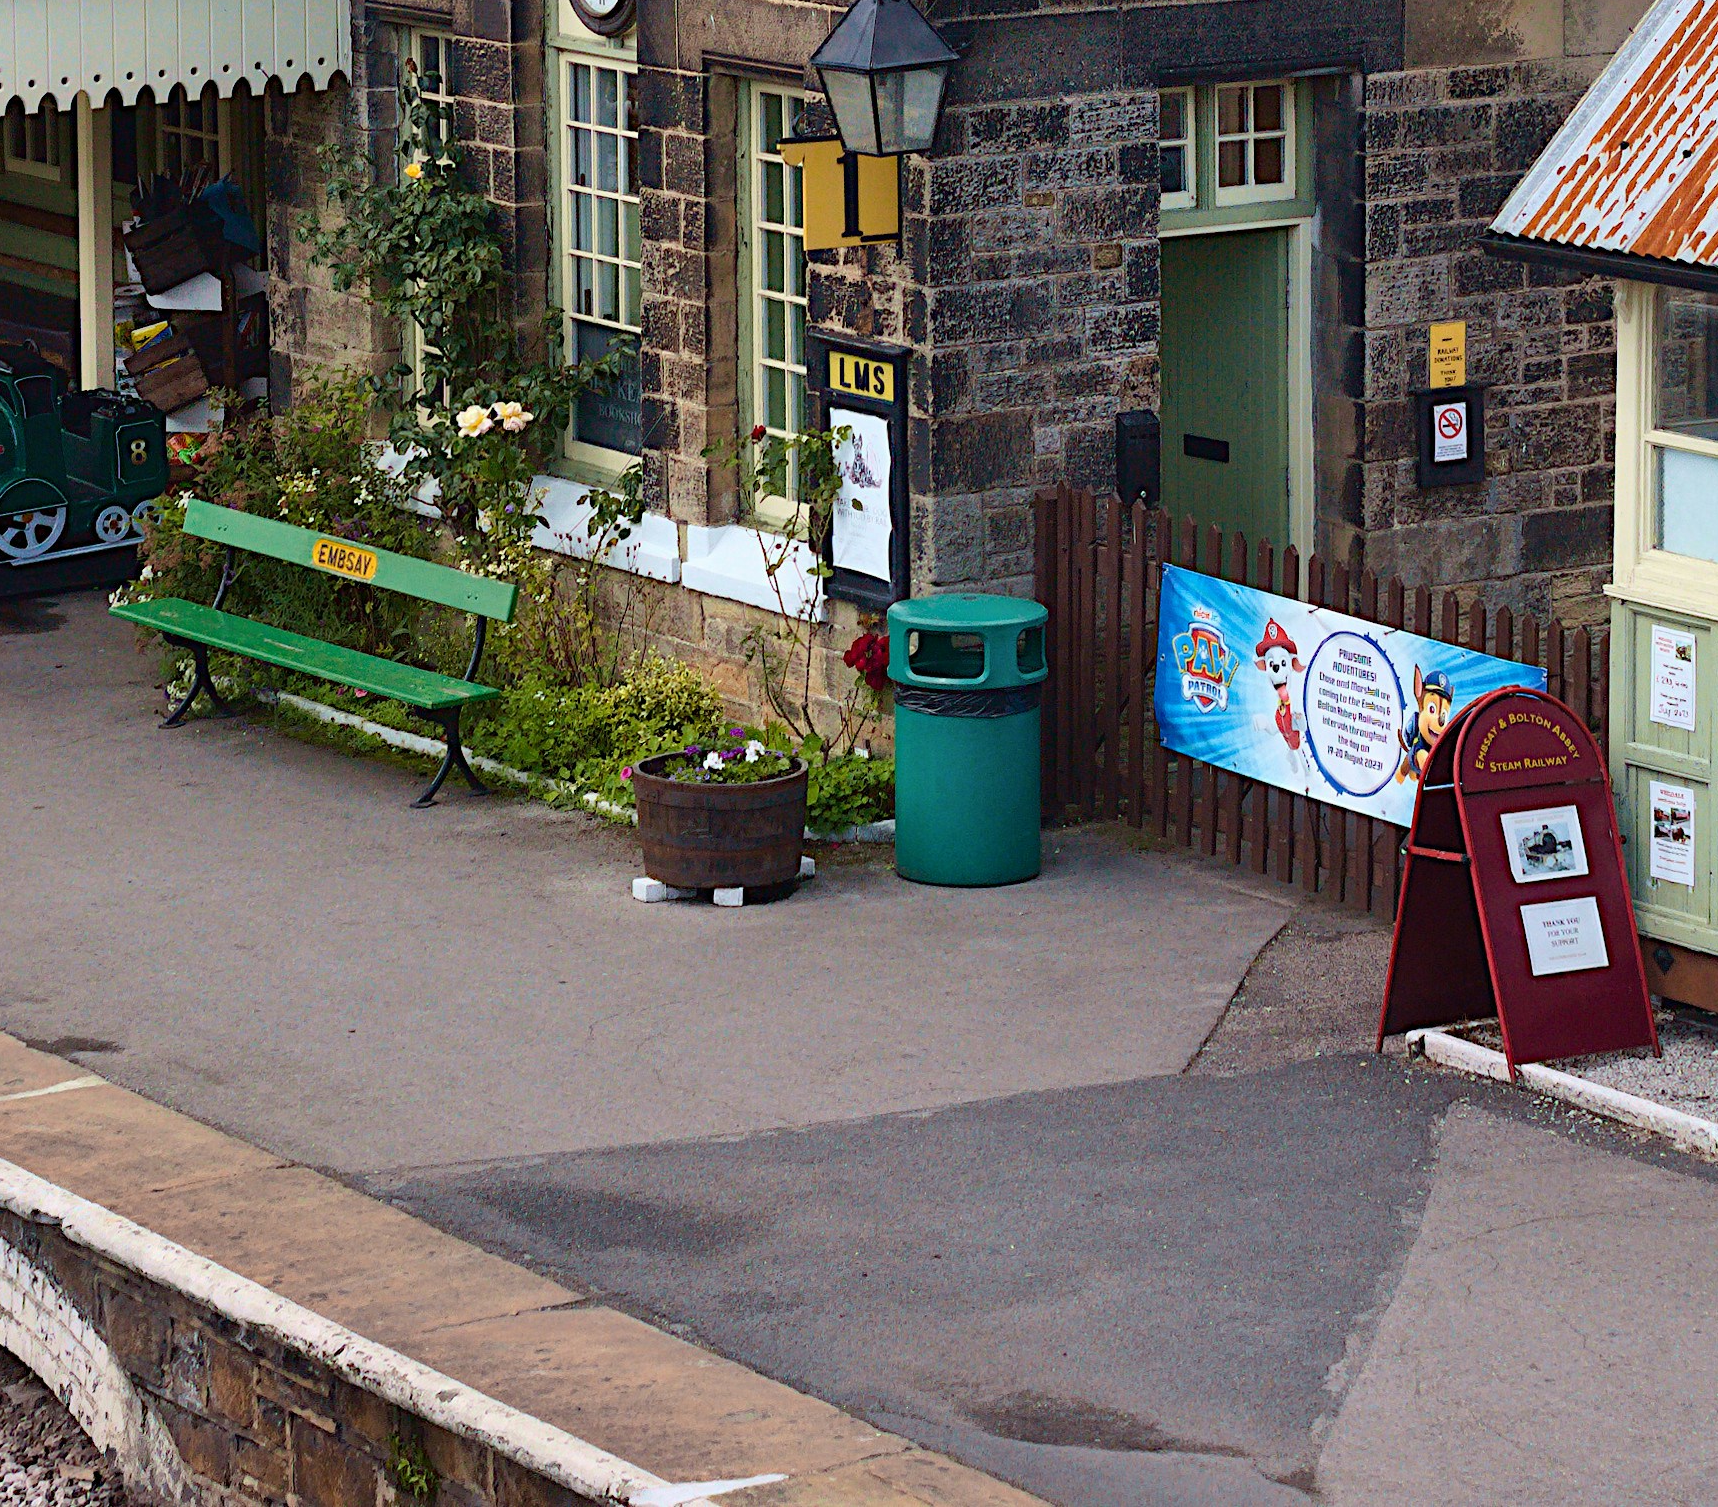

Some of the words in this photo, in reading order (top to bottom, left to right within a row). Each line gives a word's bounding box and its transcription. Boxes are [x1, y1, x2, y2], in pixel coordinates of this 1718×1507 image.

[838, 356, 885, 395] LMS
[130, 438, 146, 466] 8
[318, 543, 372, 576] EMBSAY
[1172, 632, 1240, 688] PAW
[1338, 648, 1372, 667] PAWSOME
[1332, 661, 1377, 682] ADVENTURES!
[1188, 680, 1223, 699] PATROL
[1319, 671, 1335, 685] Chase
[1336, 678, 1350, 689] and
[1350, 681, 1380, 698] Marshall
[1380, 691, 1391, 702] are
[1318, 687, 1339, 704] coming
[1339, 693, 1347, 703] to
[1348, 694, 1360, 707] the
[1361, 698, 1386, 716] Embsay
[1317, 699, 1337, 713] Bolton
[1337, 706, 1357, 722] Abbey
[1358, 712, 1385, 730] Railway
[1385, 721, 1391, 731] at
[1322, 714, 1349, 730] intervals
[1349, 724, 1388, 744] throughout
[1338, 734, 1349, 745] the
[1349, 738, 1360, 752] day
[1360, 744, 1370, 753] on
[1475, 726, 1498, 770] EMBSAY
[1498, 718, 1507, 730] &
[1508, 713, 1551, 730] BOLTON
[1551, 724, 1580, 759] ABBEY
[1344, 750, 1363, 766] August
[1364, 758, 1384, 771] 2023!
[1489, 760, 1522, 773] STEAM
[1523, 755, 1568, 769] RAILWAY
[1542, 919, 1565, 928] THANK
[1566, 917, 1580, 925] YOU
[1547, 930, 1560, 938] FOR
[1561, 927, 1579, 935] YOUR
[1551, 937, 1579, 948] SUPPORT
